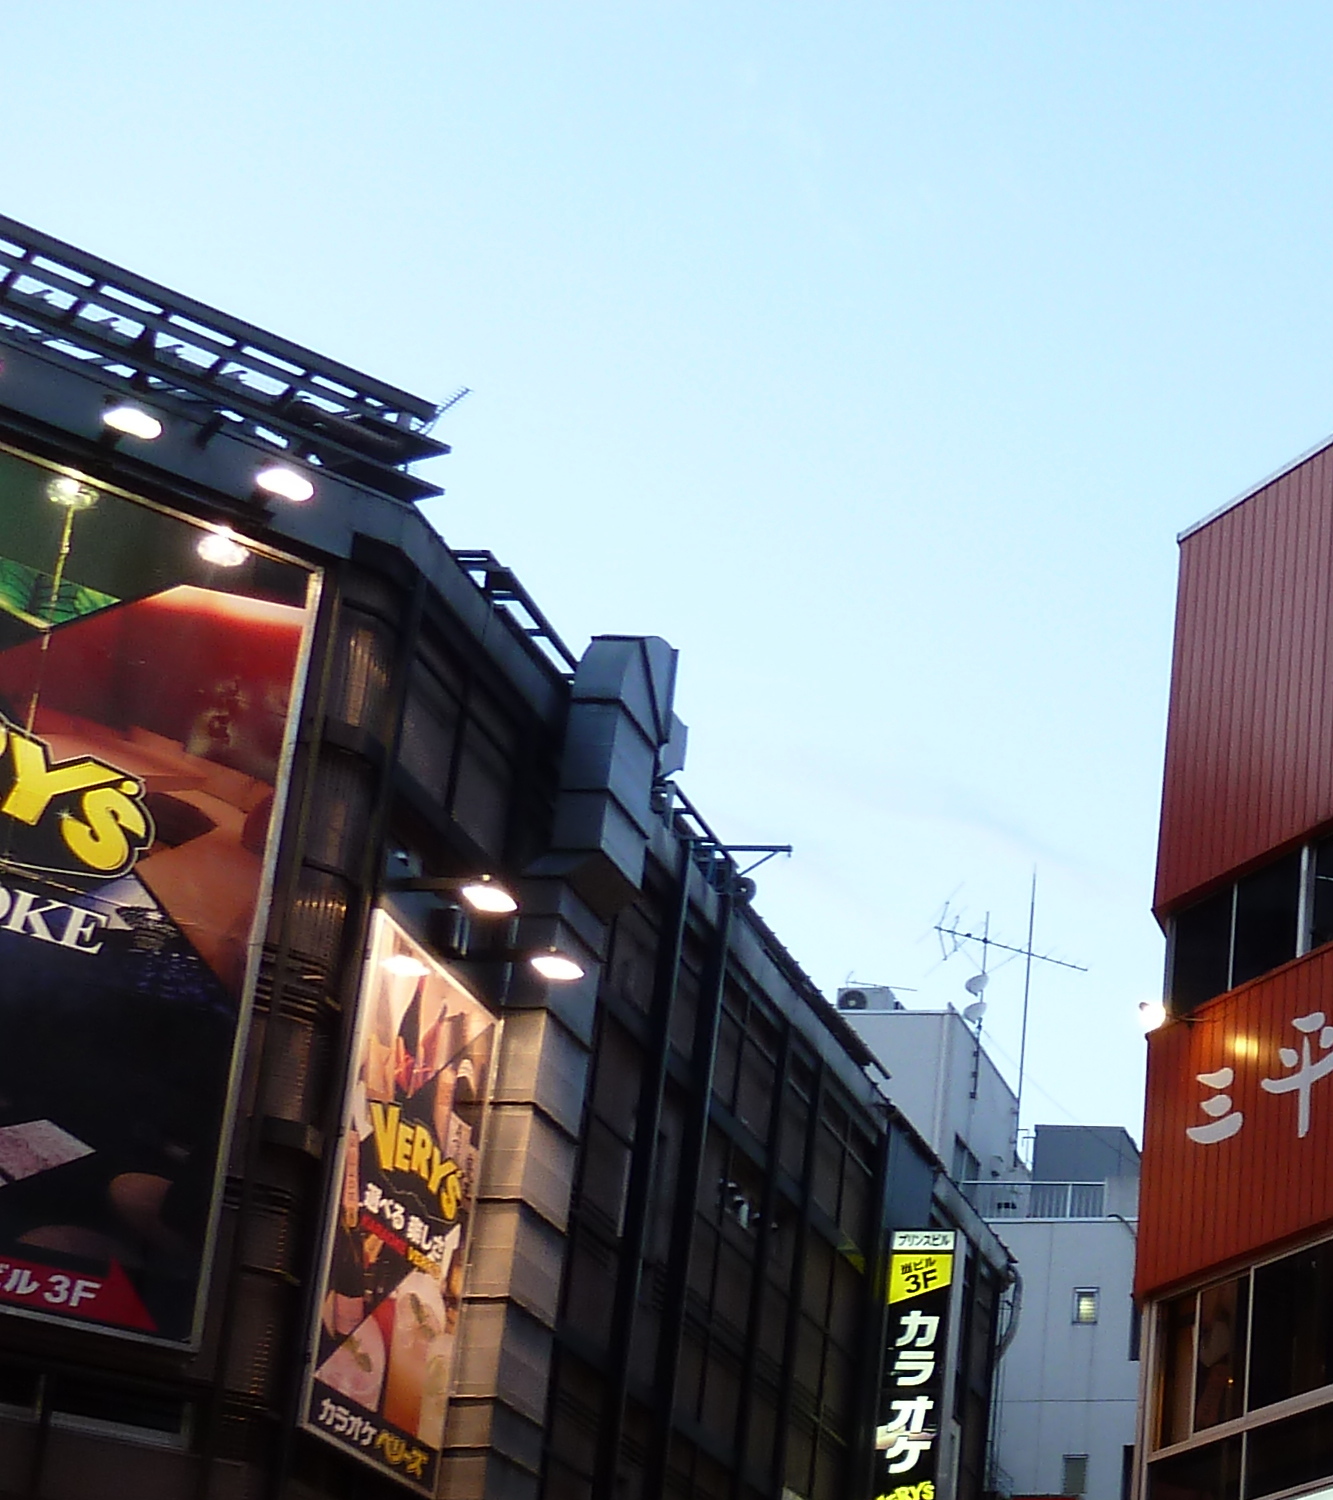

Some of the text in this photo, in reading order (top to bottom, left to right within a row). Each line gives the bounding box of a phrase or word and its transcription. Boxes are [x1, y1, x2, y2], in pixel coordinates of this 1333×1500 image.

[899, 1232, 951, 1248] プリンスビル
[43, 1274, 103, 1307] 3F
[904, 1267, 938, 1294] 3F
[885, 1310, 941, 1474] カラオケ
[318, 1397, 378, 1446] カラオケ
